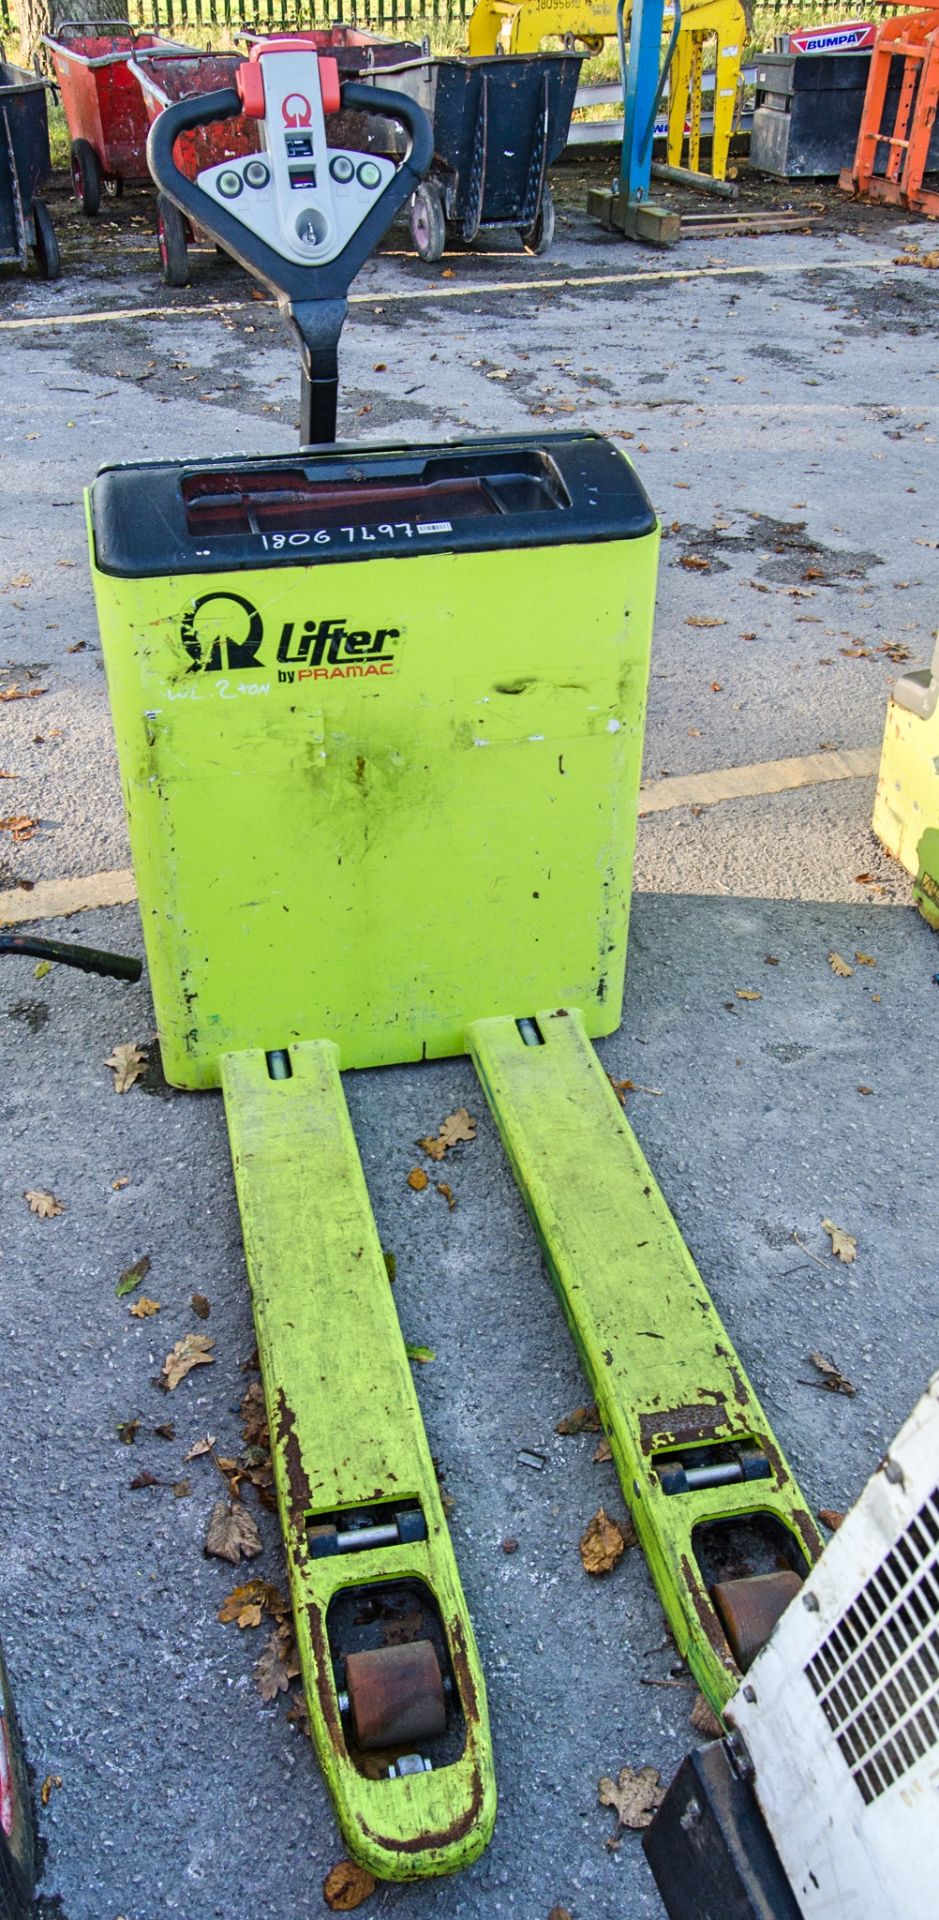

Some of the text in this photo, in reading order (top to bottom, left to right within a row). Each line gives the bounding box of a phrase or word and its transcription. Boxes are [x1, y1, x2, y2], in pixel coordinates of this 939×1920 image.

[806, 34, 857, 50] BUMPA
[276, 618, 400, 666] Lifter
[278, 663, 394, 684] by PRAMAC
